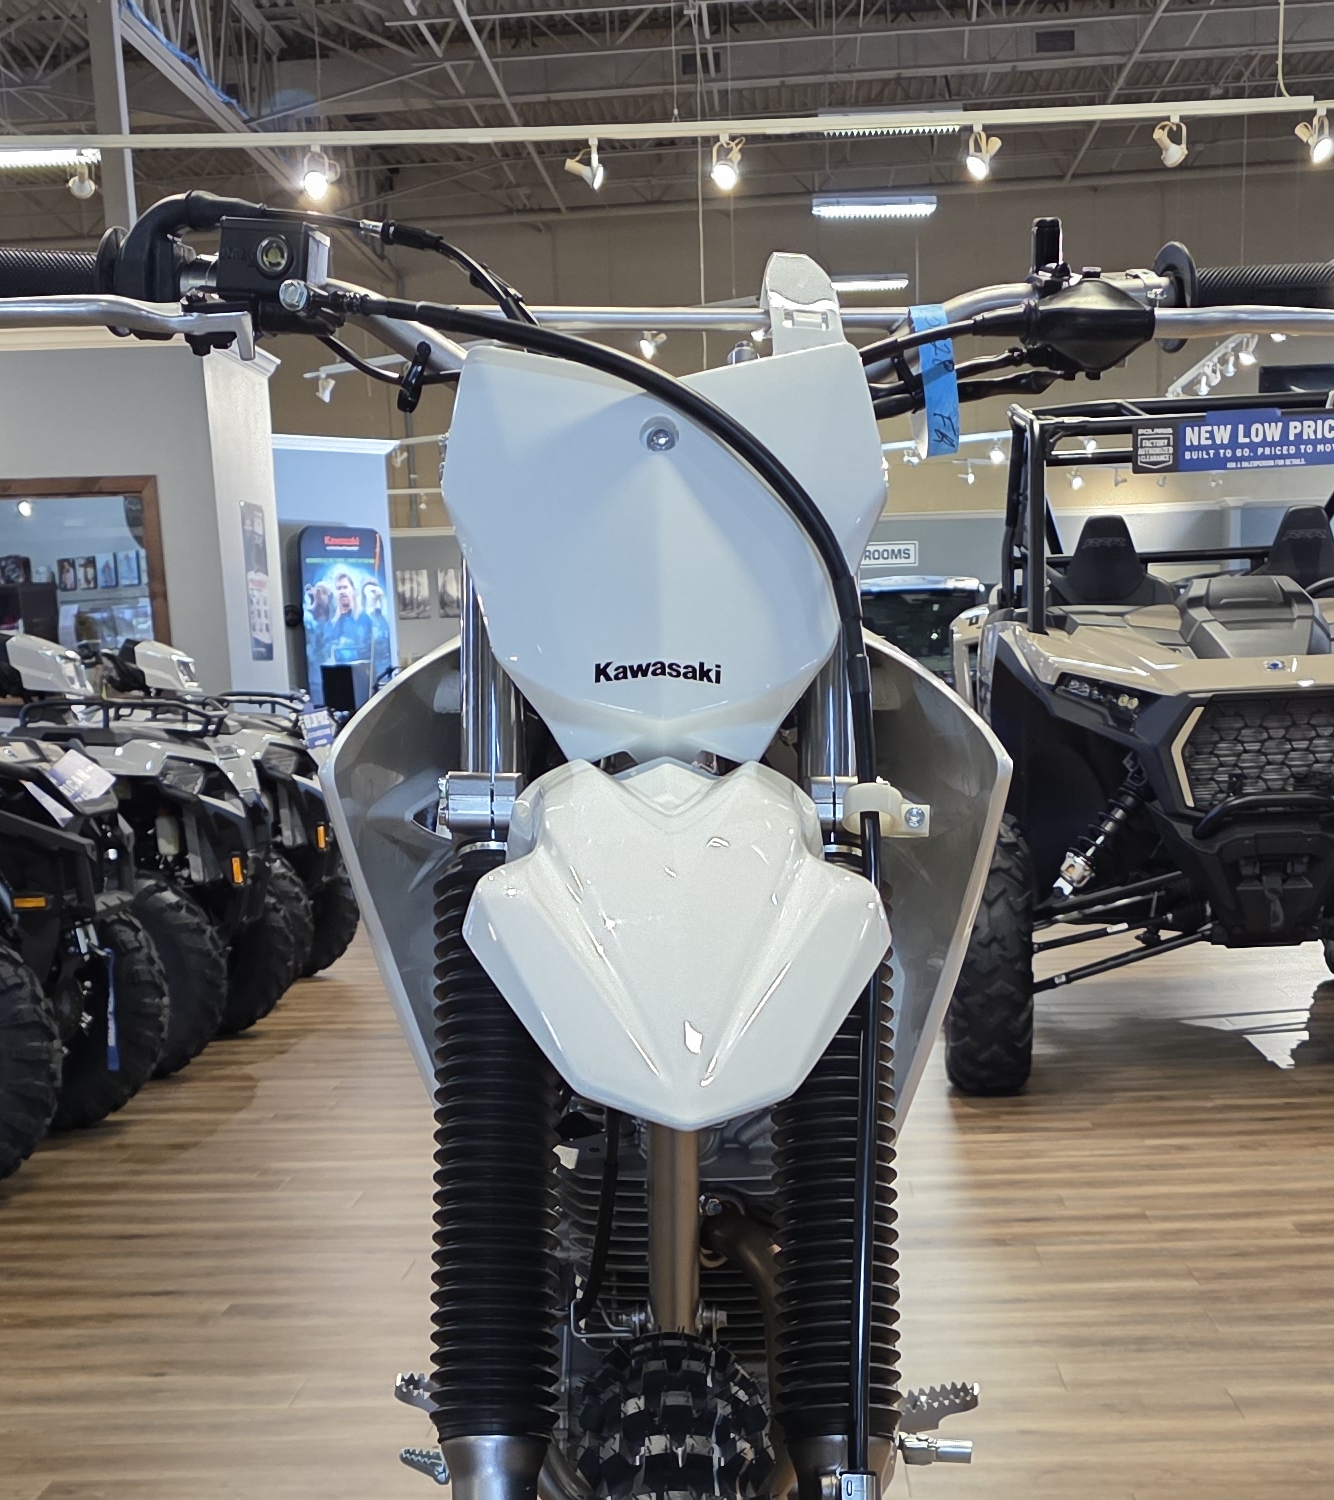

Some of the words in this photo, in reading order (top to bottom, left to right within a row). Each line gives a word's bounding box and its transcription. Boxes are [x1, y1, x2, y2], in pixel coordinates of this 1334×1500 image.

[1185, 425, 1232, 446] NEW
[1238, 422, 1283, 443] LOW
[1184, 449, 1215, 460] BUILT
[1219, 448, 1233, 458] TO
[1257, 445, 1296, 456] PRICED
[1300, 444, 1314, 454] TO
[864, 548, 911, 561] ROOMS
[594, 660, 722, 685] Kawasaki
